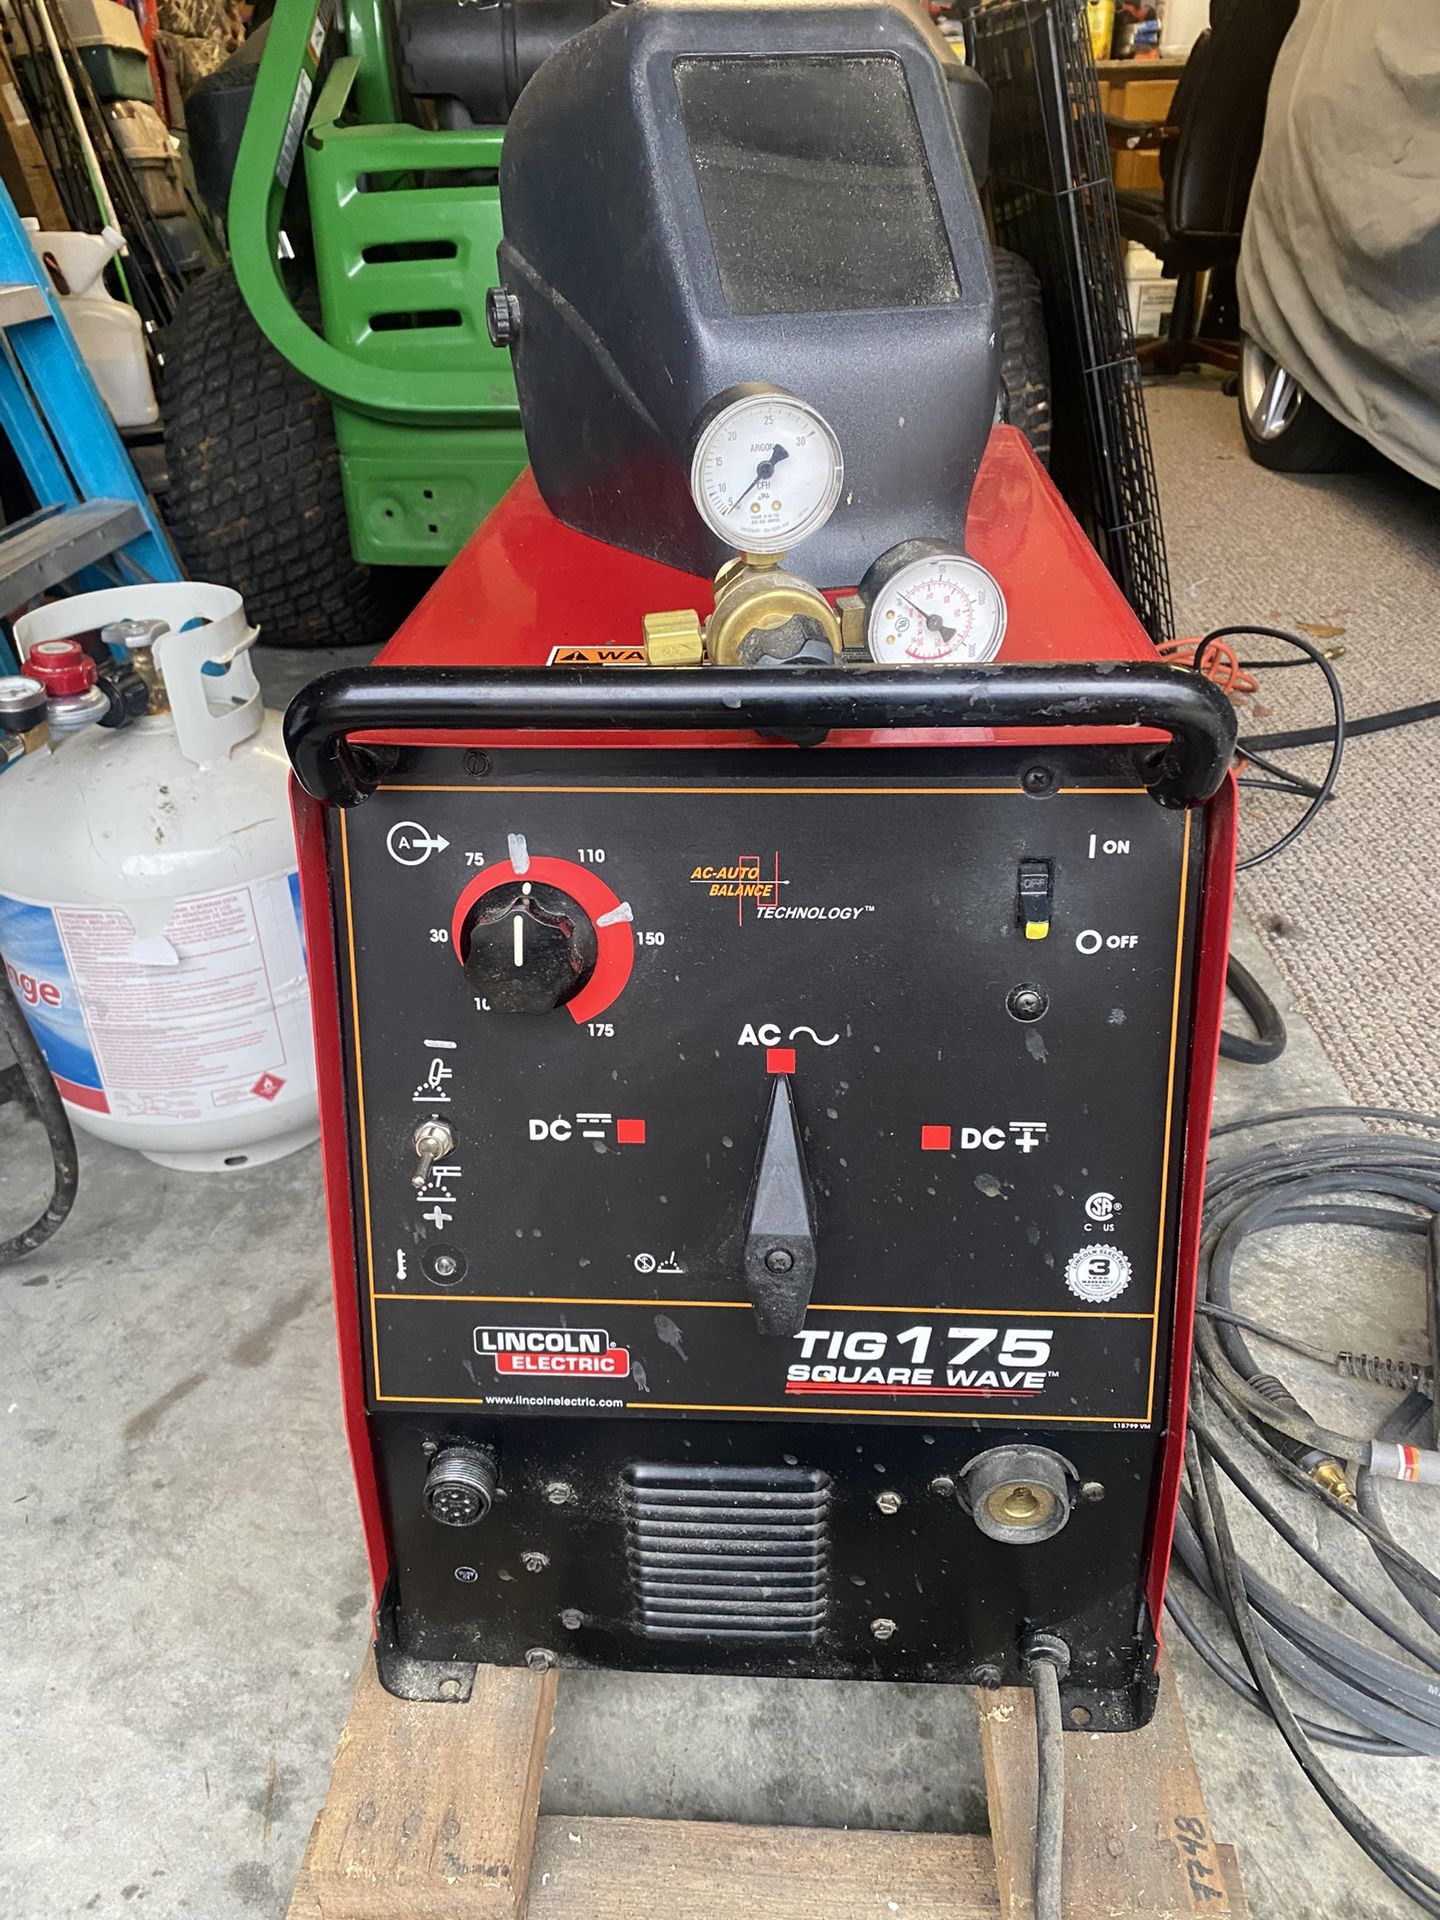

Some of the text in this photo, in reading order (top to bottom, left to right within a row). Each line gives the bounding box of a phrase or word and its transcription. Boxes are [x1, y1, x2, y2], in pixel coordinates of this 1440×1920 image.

[764, 415, 774, 426] 25
[727, 431, 737, 441] 20
[796, 436, 806, 446] 30
[750, 443, 775, 453] ARGON
[715, 457, 723, 467] 15
[718, 483, 727, 493] 10
[757, 481, 771, 490] CFH
[398, 837, 411, 849] A
[1102, 840, 1130, 854] ON
[465, 852, 485, 866] 75
[577, 849, 606, 863] 110
[690, 866, 760, 880] AC-AUTO
[709, 884, 773, 897] BALANCE
[429, 929, 449, 943] 30
[637, 932, 665, 945] 150
[1106, 935, 1139, 949] OFF
[588, 1023, 615, 1037] 175
[737, 1023, 781, 1047] AC
[529, 1118, 572, 1141] DC
[960, 1127, 1006, 1150] DC
[1083, 1222, 1115, 1232] C US
[1072, 1249, 1126, 1270] LINCOLN ELECTRIC
[1088, 1259, 1110, 1276] 3
[482, 1331, 600, 1353] LINCOLN
[511, 1355, 615, 1372] ELECTRIC
[787, 1365, 934, 1386] SQUARE
[485, 1395, 624, 1408] www.lincolnelectric.com
